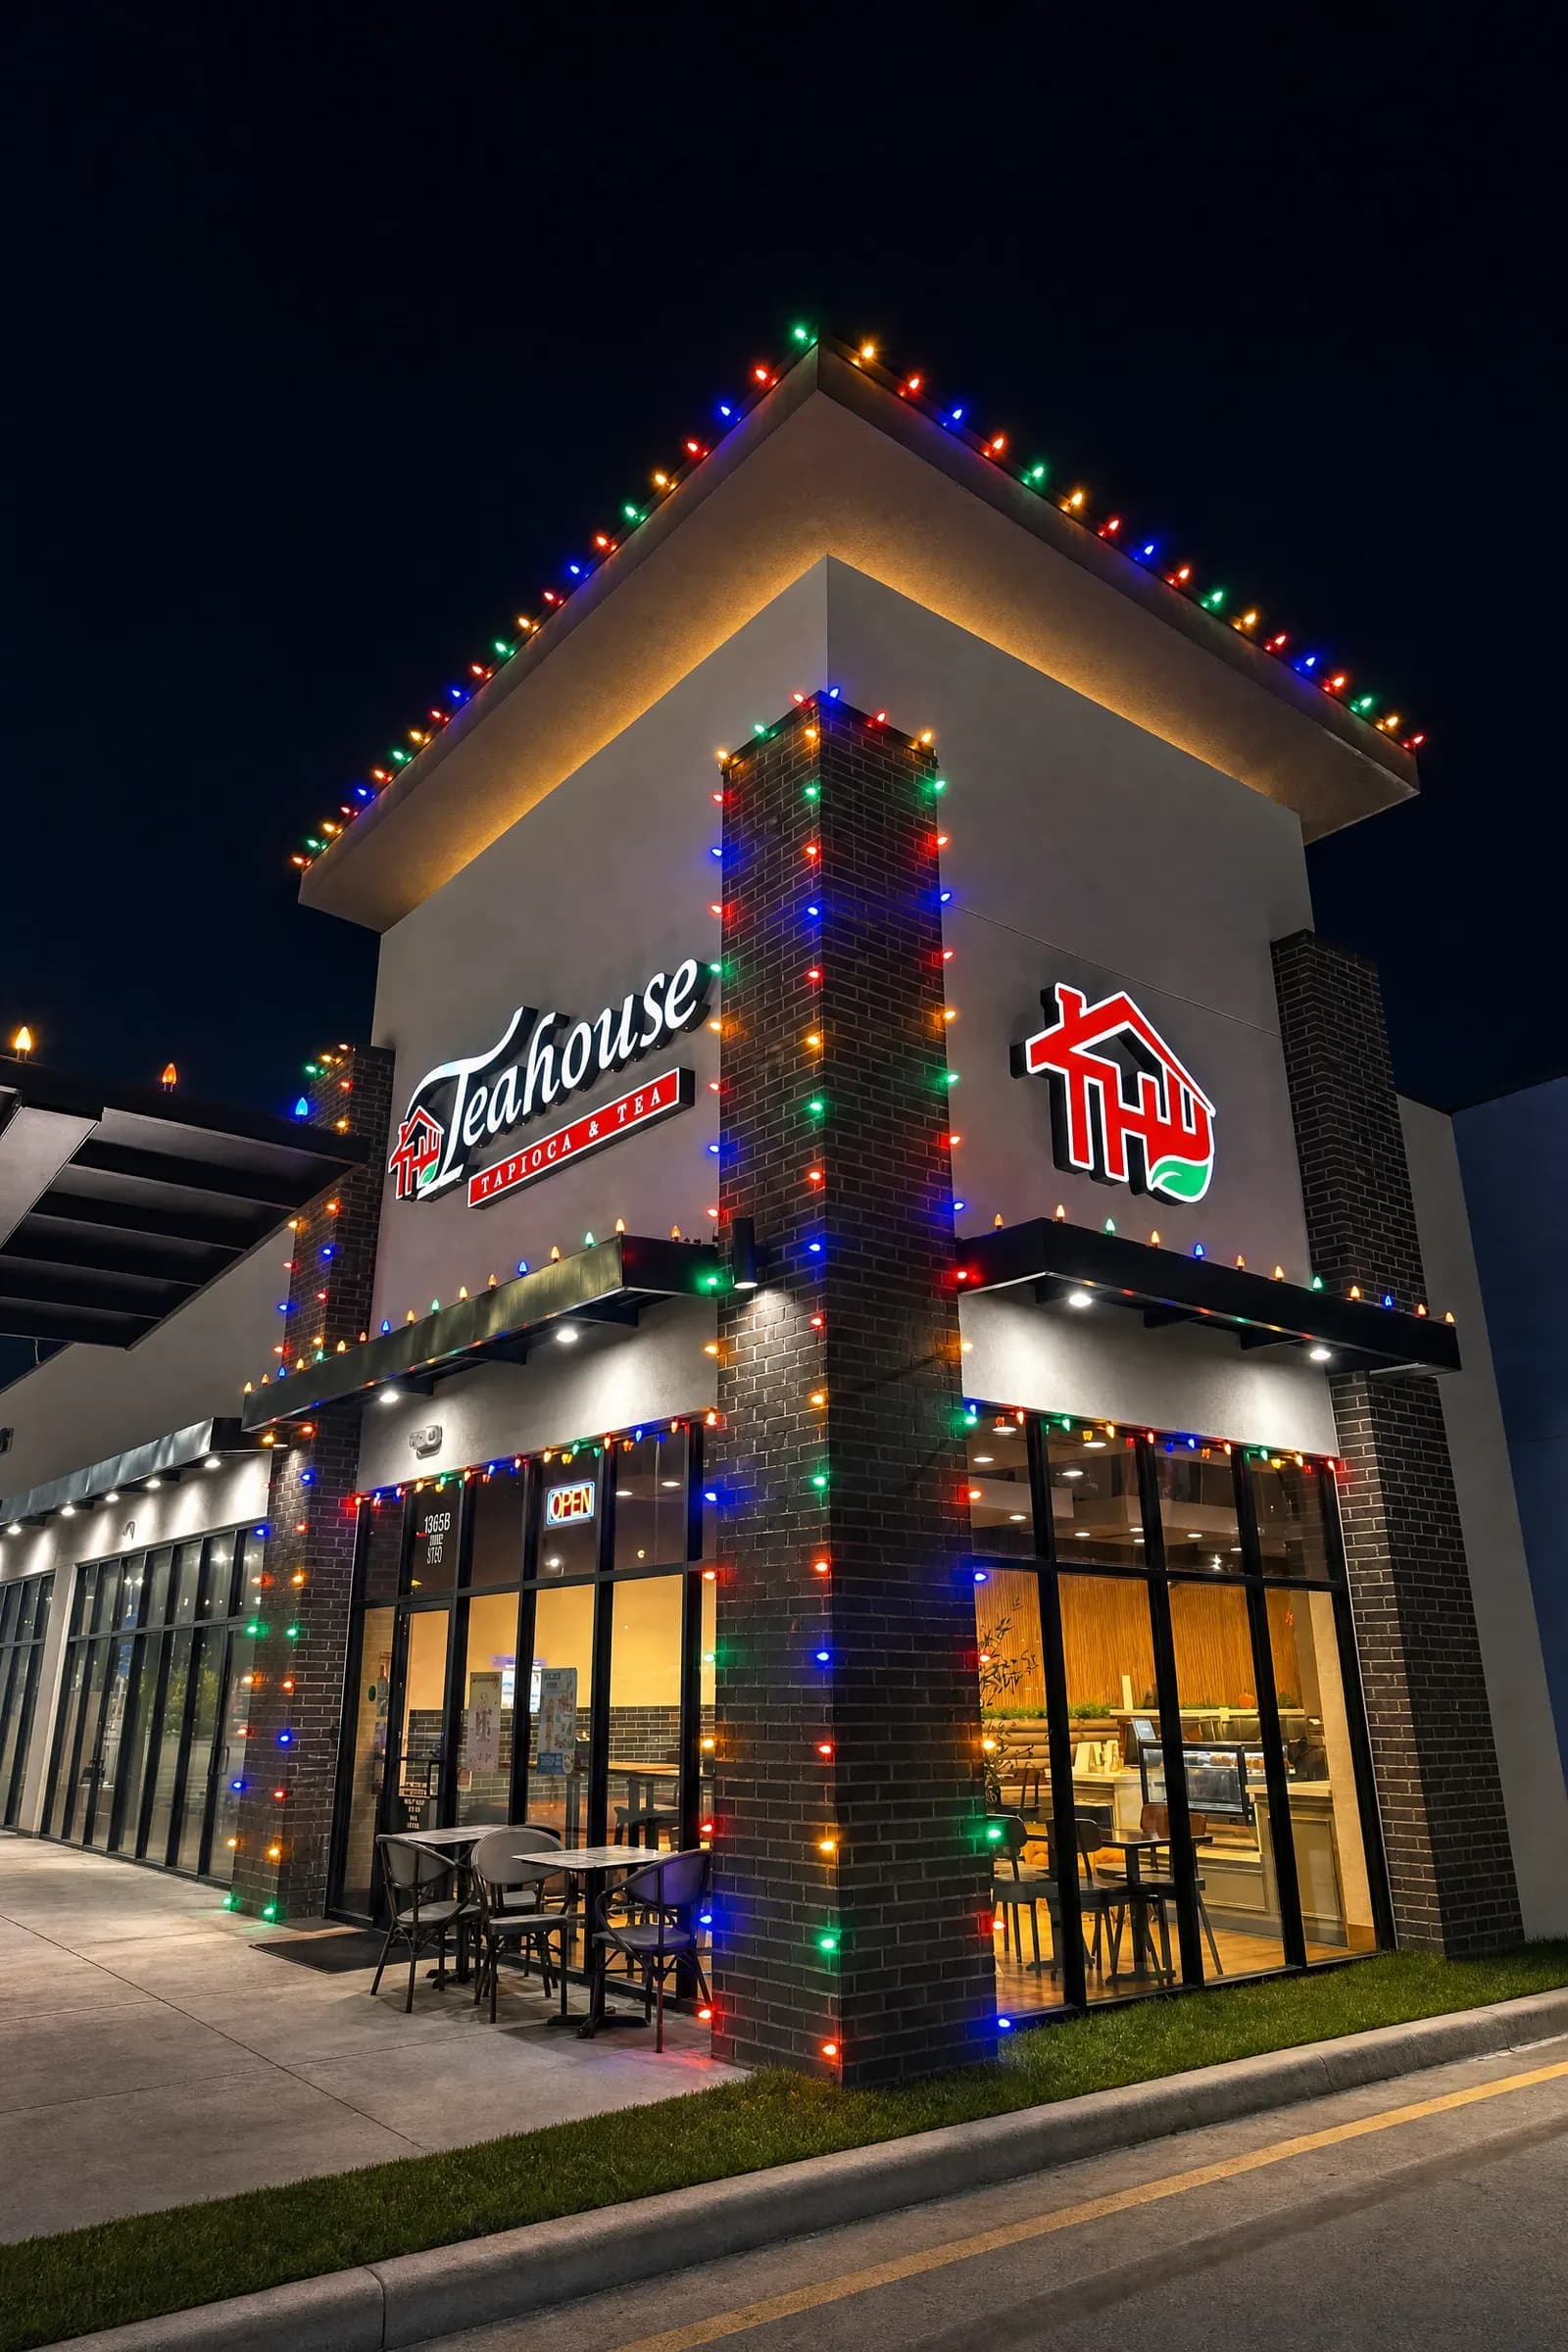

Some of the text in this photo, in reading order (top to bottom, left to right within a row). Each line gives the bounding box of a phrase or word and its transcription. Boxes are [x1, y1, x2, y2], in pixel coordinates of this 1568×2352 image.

[405, 958, 699, 1200] Teahouse
[481, 1087, 662, 1193] TAPIOCA & TEA
[551, 1487, 592, 1521] OPEN
